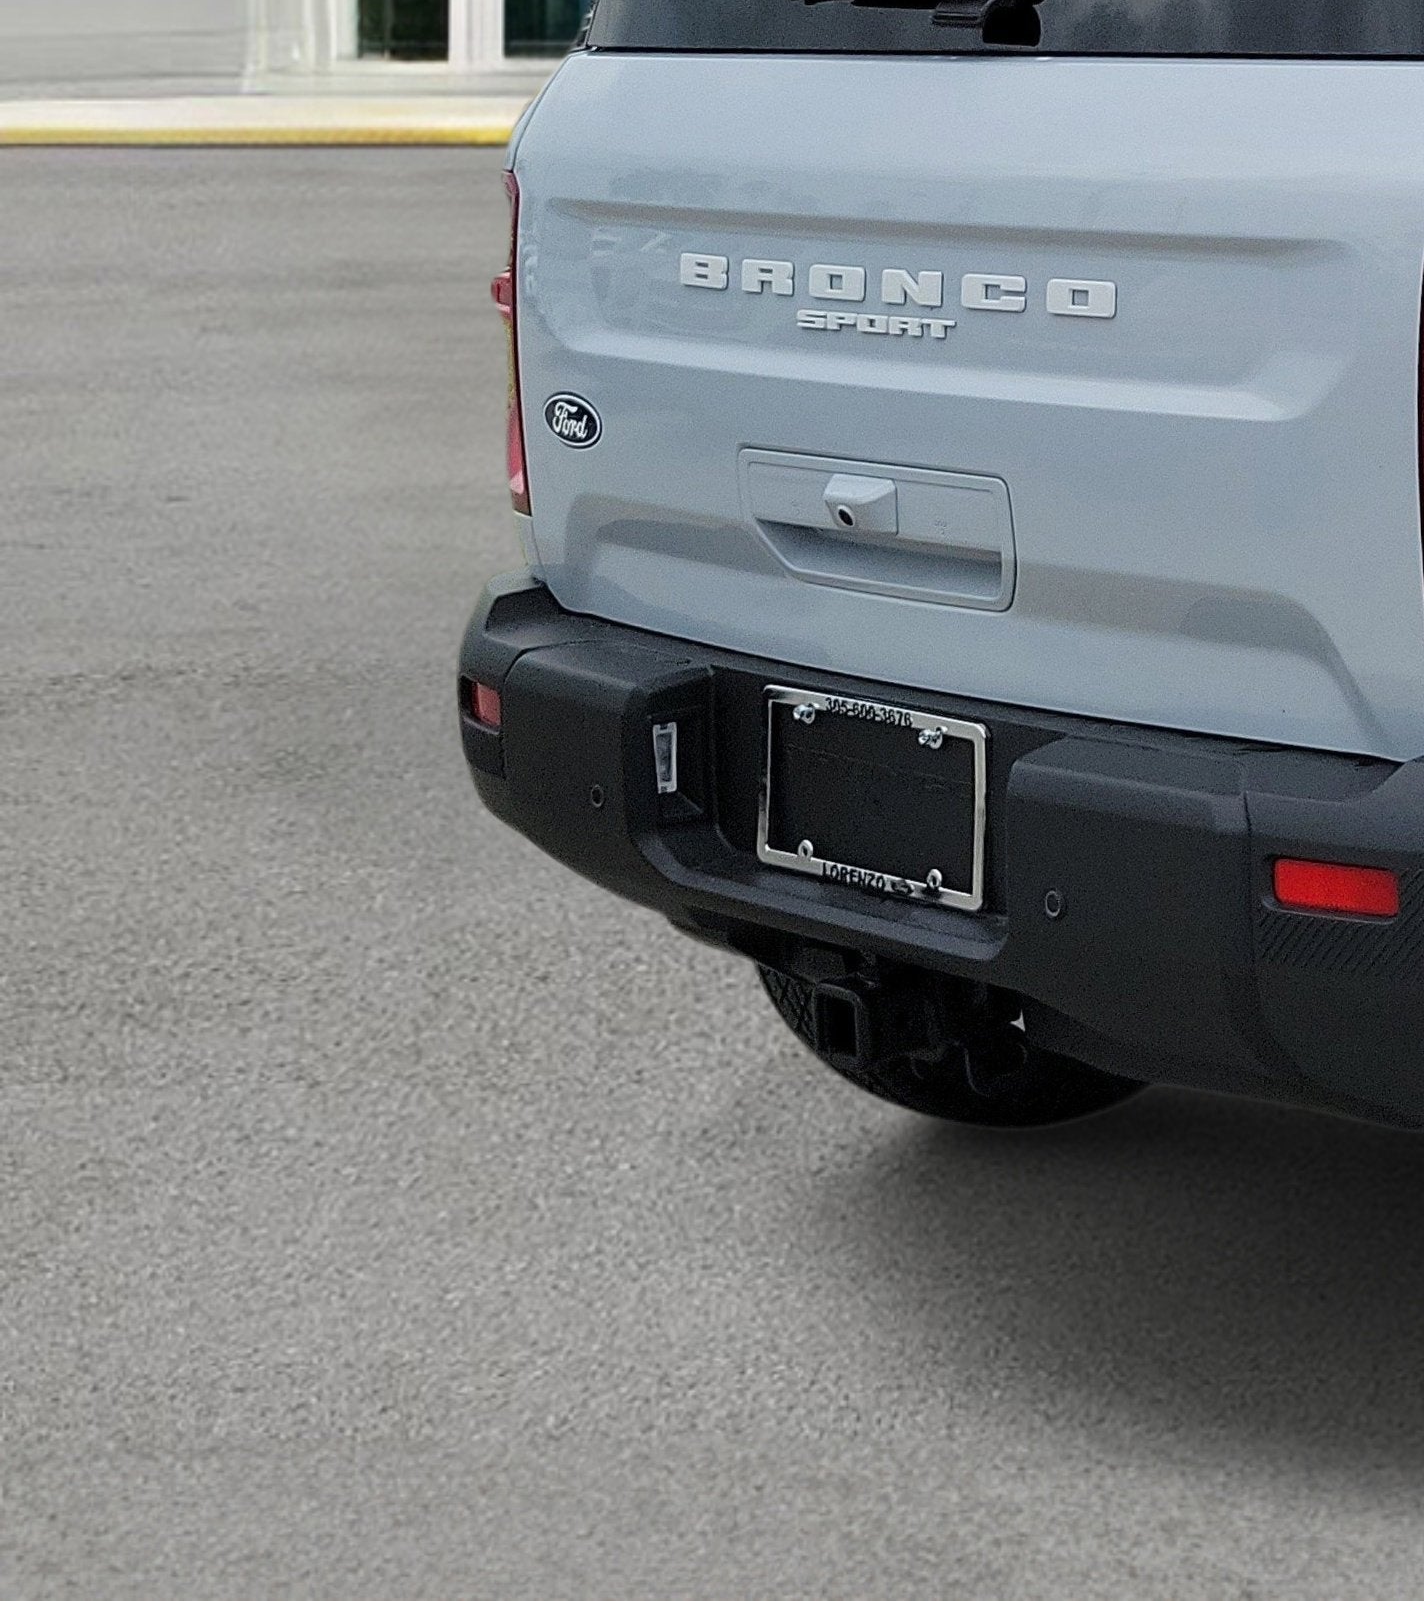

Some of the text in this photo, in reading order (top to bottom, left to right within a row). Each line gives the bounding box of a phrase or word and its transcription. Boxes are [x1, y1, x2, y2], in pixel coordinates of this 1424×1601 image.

[680, 252, 1118, 318] BRONCO
[797, 309, 957, 339] SPORT
[552, 401, 588, 439] Ford
